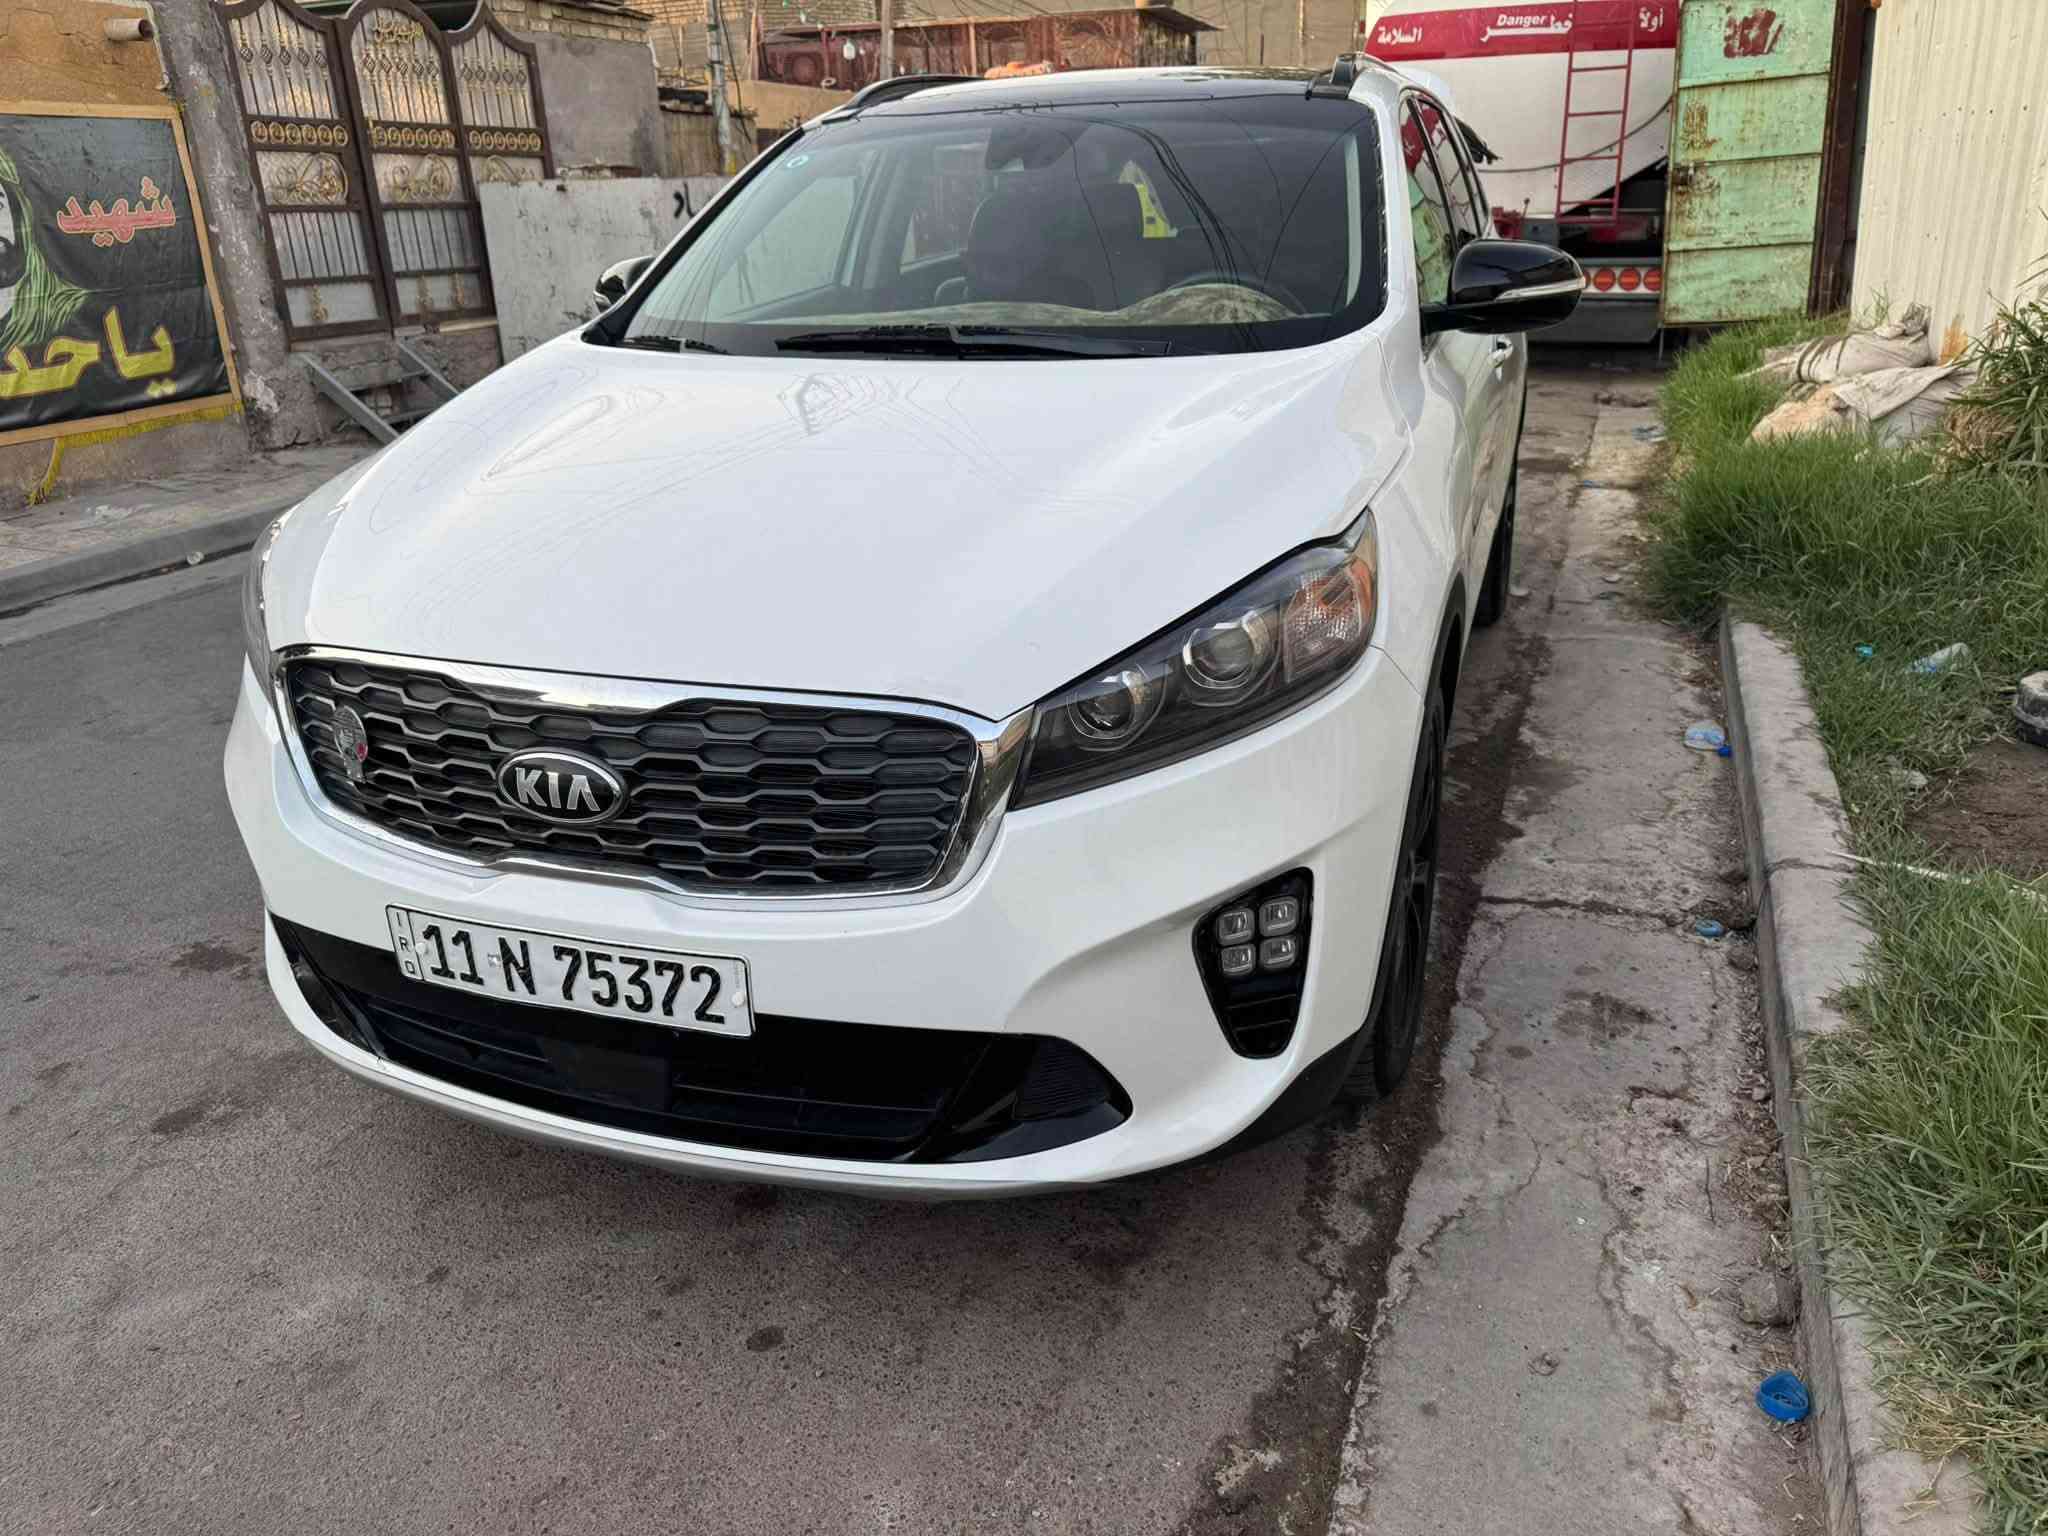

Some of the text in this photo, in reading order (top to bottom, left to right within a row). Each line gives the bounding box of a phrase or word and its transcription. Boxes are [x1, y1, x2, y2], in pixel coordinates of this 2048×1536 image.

[1377, 25, 1423, 46] السلامة
[1496, 13, 1547, 28] Danger
[56, 175, 176, 247] شهيد
[515, 767, 601, 811] KIA
[422, 924, 485, 986] 11
[498, 936, 536, 996] N
[553, 944, 726, 1025] 75372
